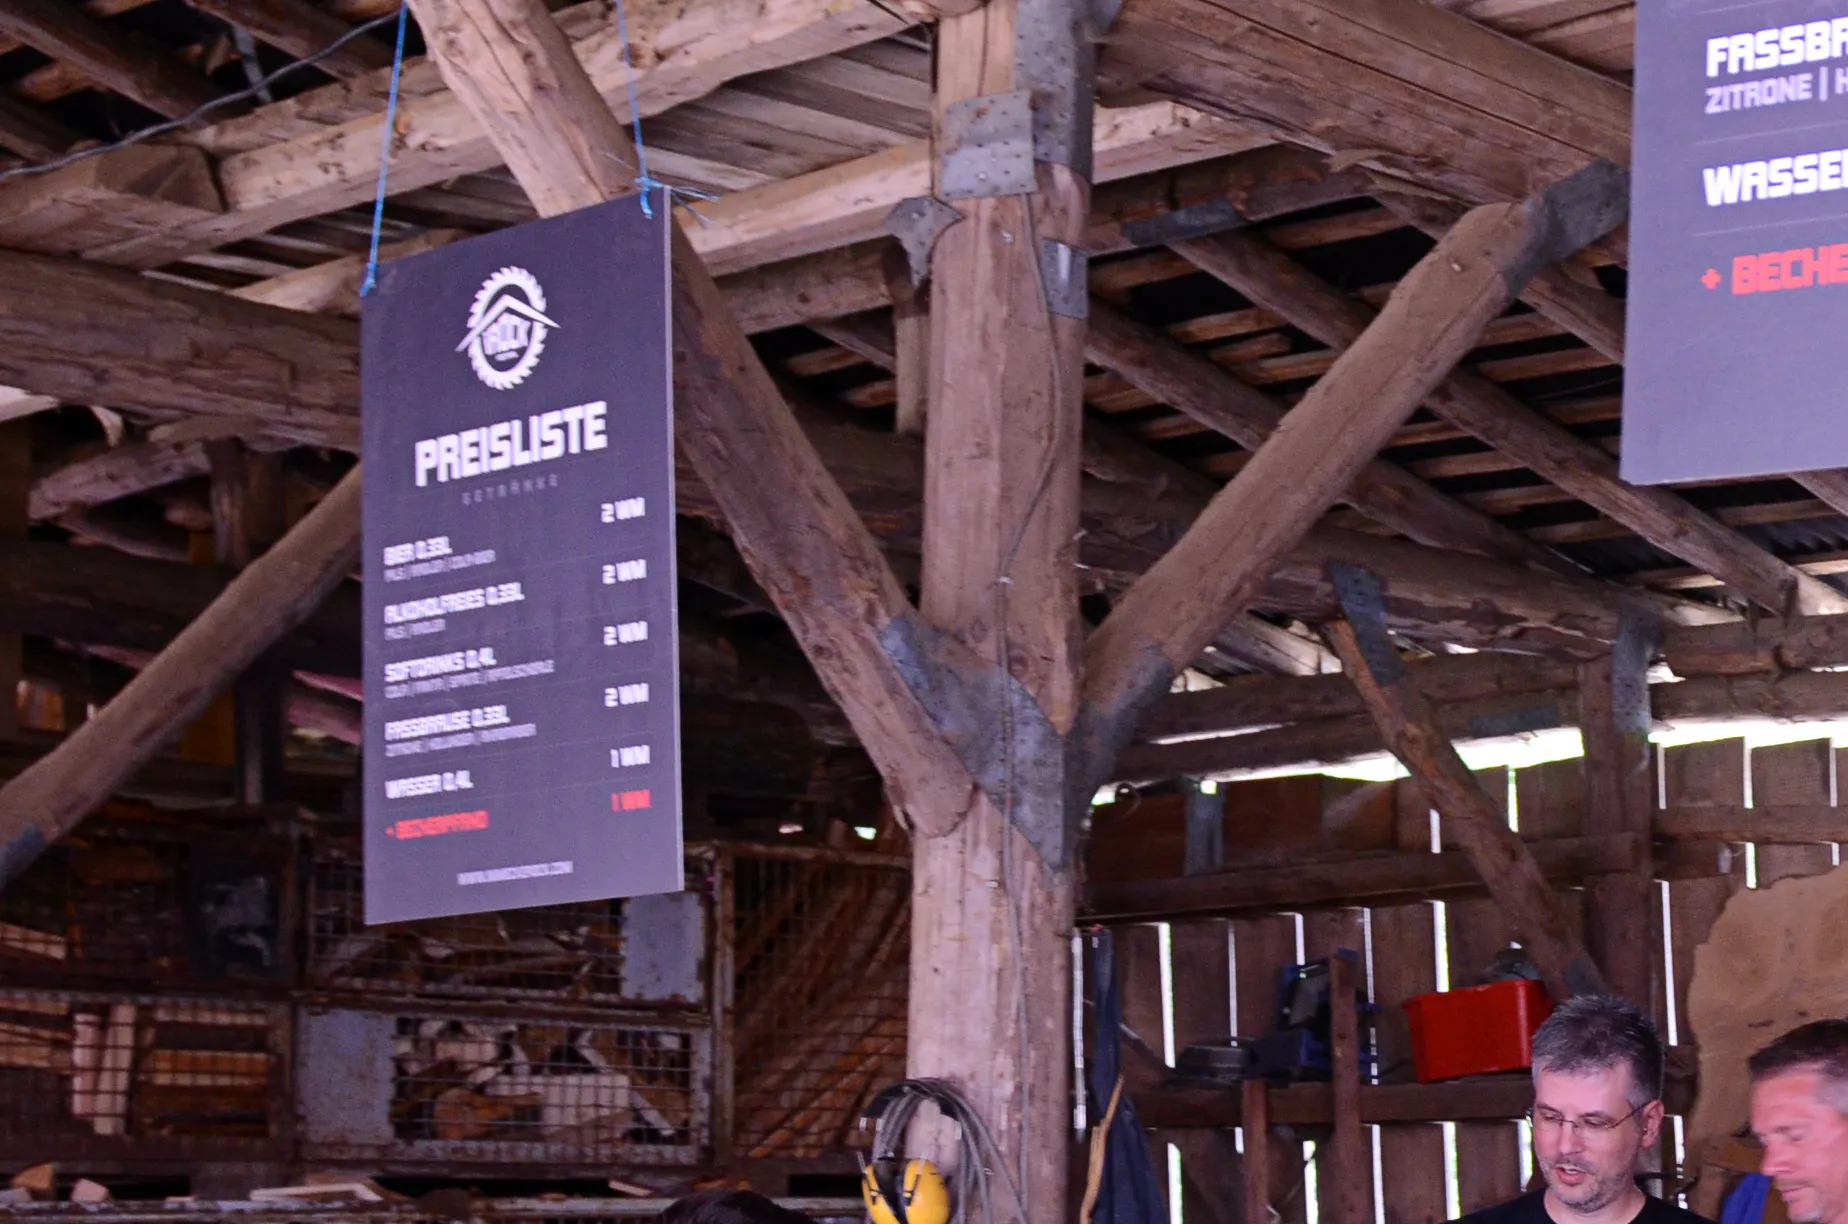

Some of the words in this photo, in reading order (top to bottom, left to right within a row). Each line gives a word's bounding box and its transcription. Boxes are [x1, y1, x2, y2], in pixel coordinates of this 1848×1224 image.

[1704, 72, 1813, 115] ZITRONE
[415, 401, 608, 488] PREISLISTE
[601, 502, 615, 523] 2
[602, 564, 616, 584] 2
[603, 626, 618, 646] 2
[605, 687, 618, 708] 2
